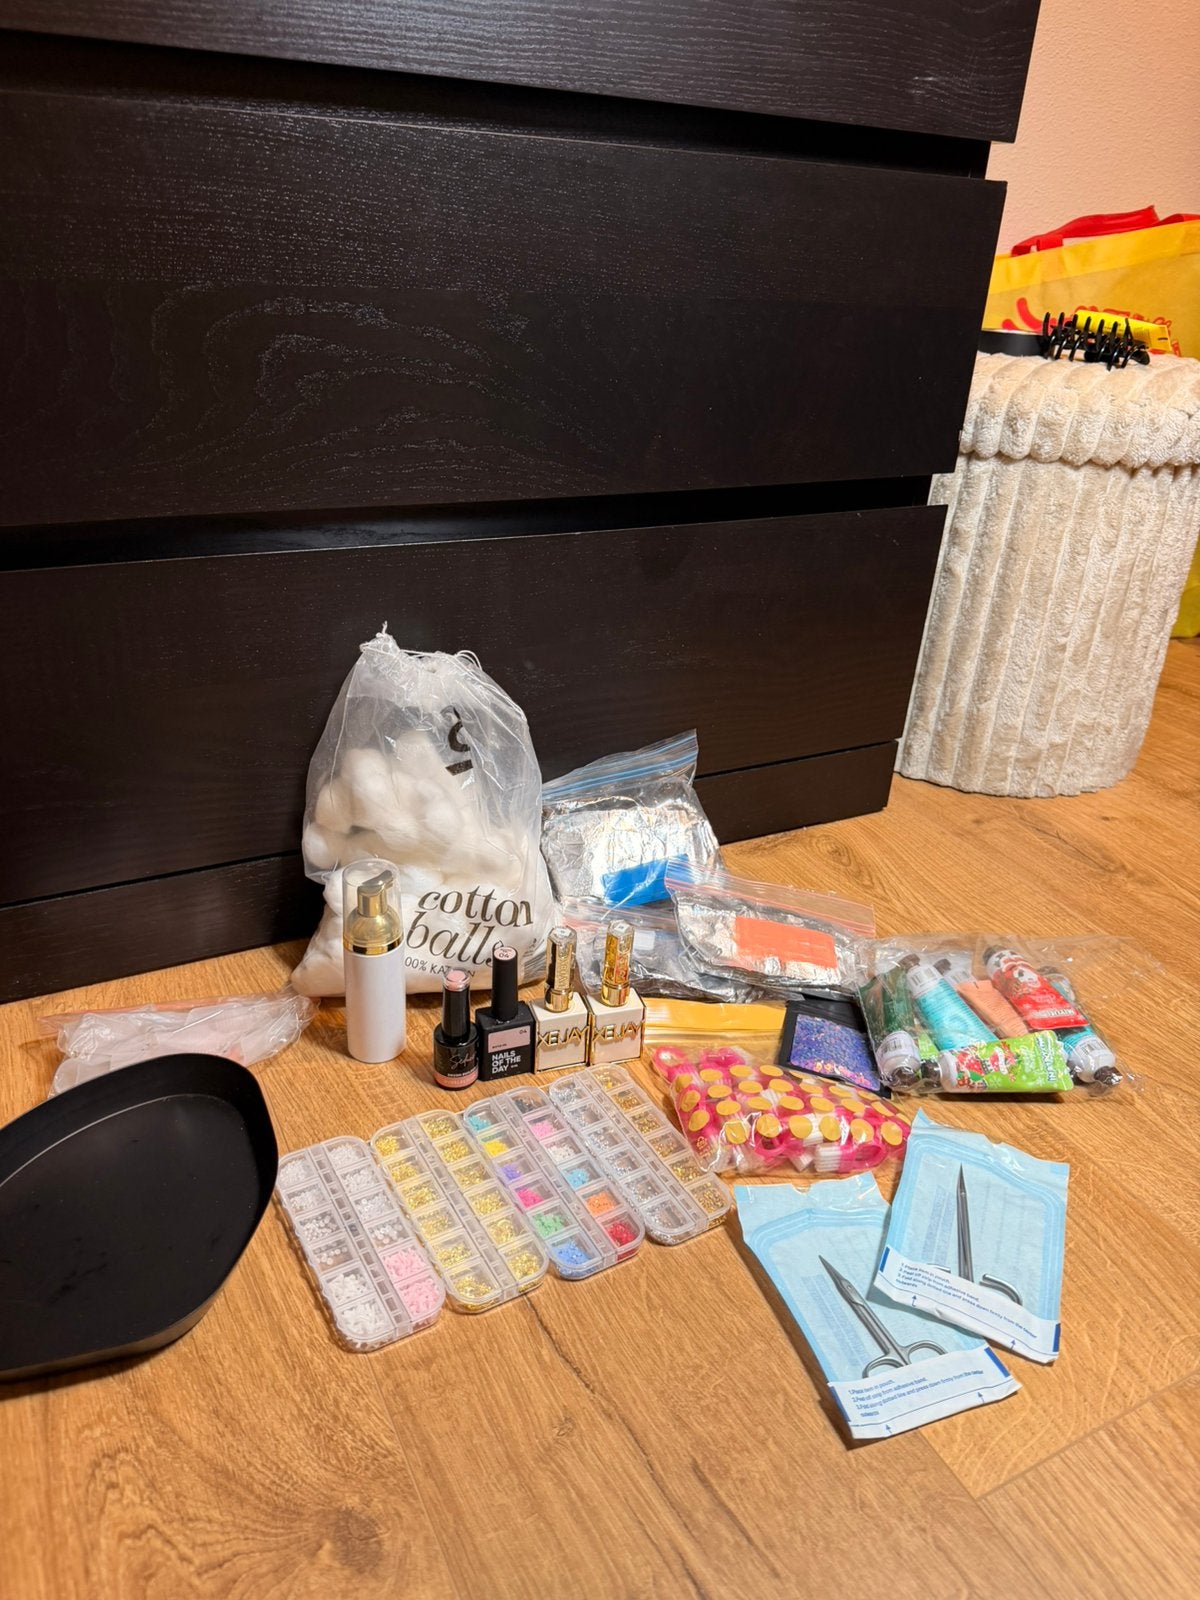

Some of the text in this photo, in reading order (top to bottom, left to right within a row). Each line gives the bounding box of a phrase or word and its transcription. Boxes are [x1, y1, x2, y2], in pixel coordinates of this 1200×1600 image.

[417, 885, 533, 928] cotton
[404, 957, 476, 978] 00% KATN
[491, 1050, 516, 1061] NAILS
[491, 1059, 504, 1068] OF
[505, 1055, 521, 1064] THE
[491, 1064, 509, 1074] DAY
